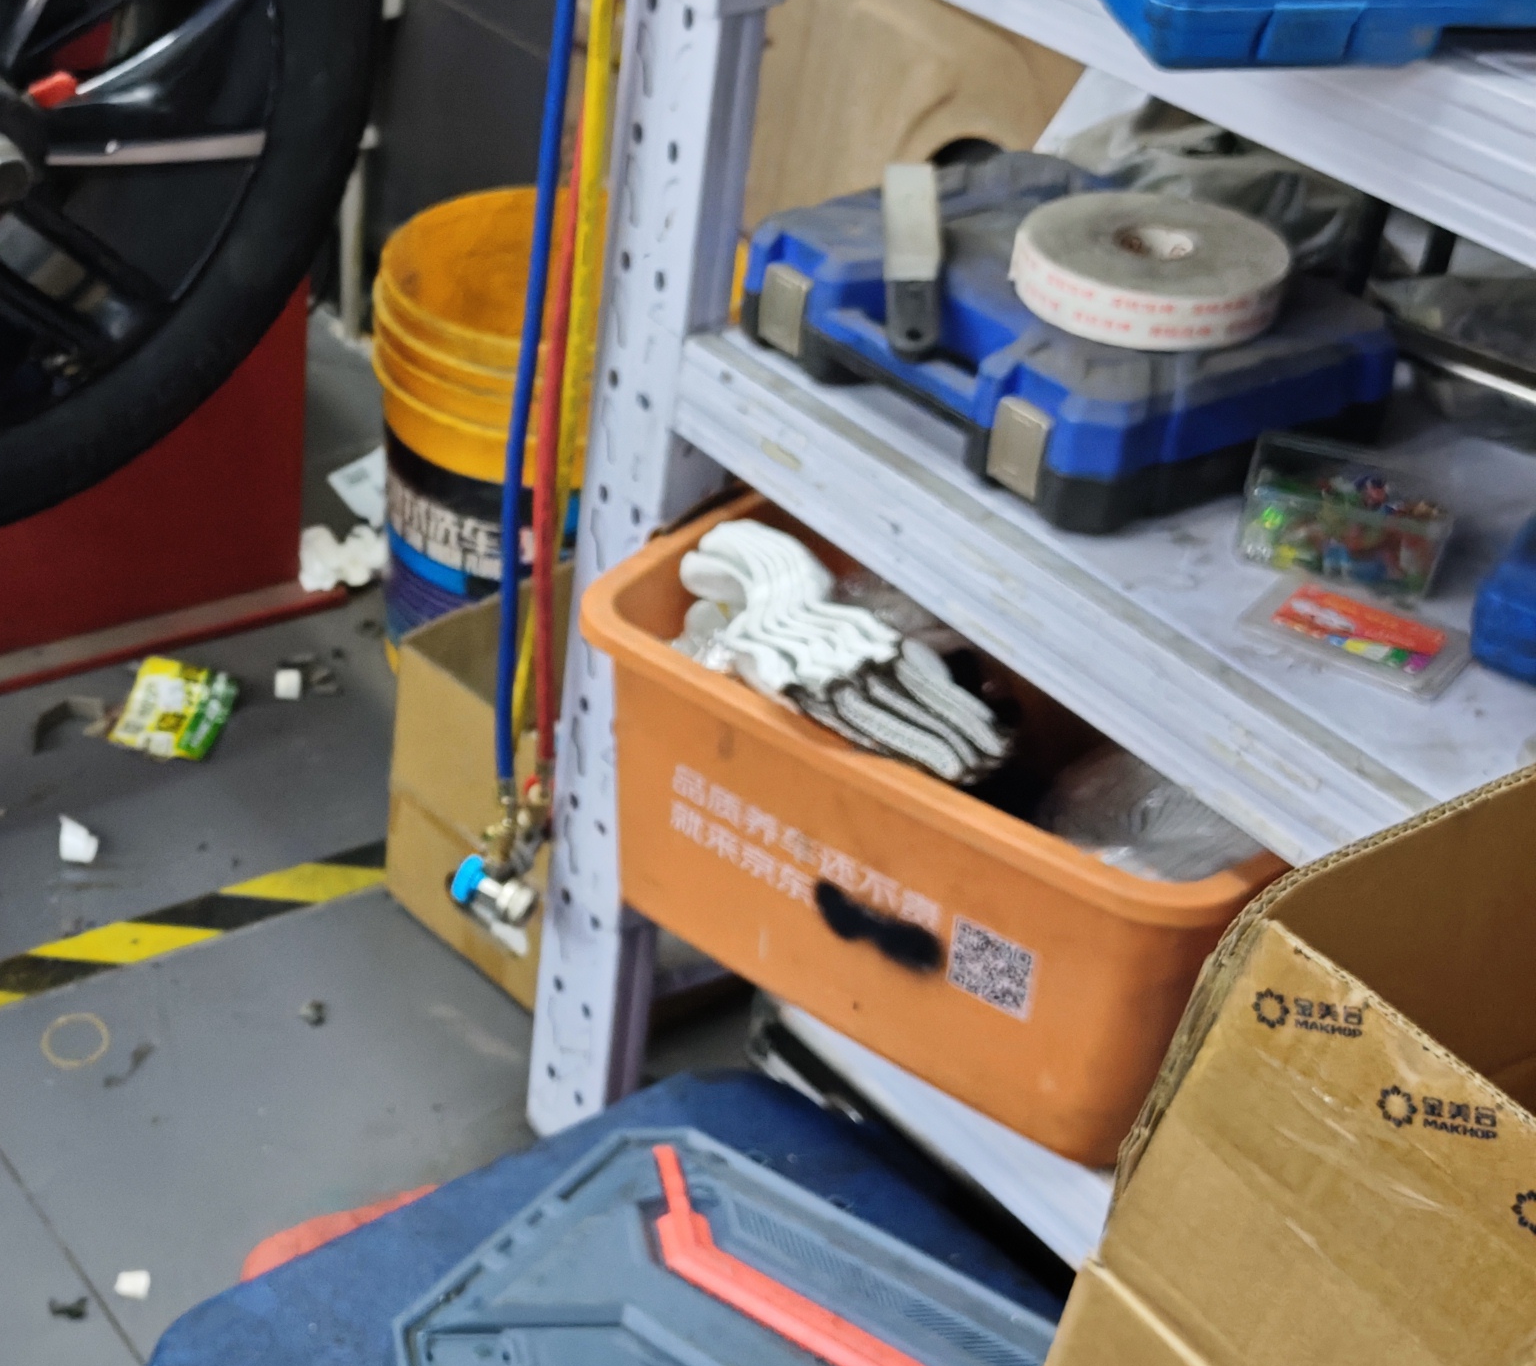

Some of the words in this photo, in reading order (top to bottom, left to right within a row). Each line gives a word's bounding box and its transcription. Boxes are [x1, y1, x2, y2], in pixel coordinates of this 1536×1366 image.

[671, 763, 943, 932] 品质养车还不贵
